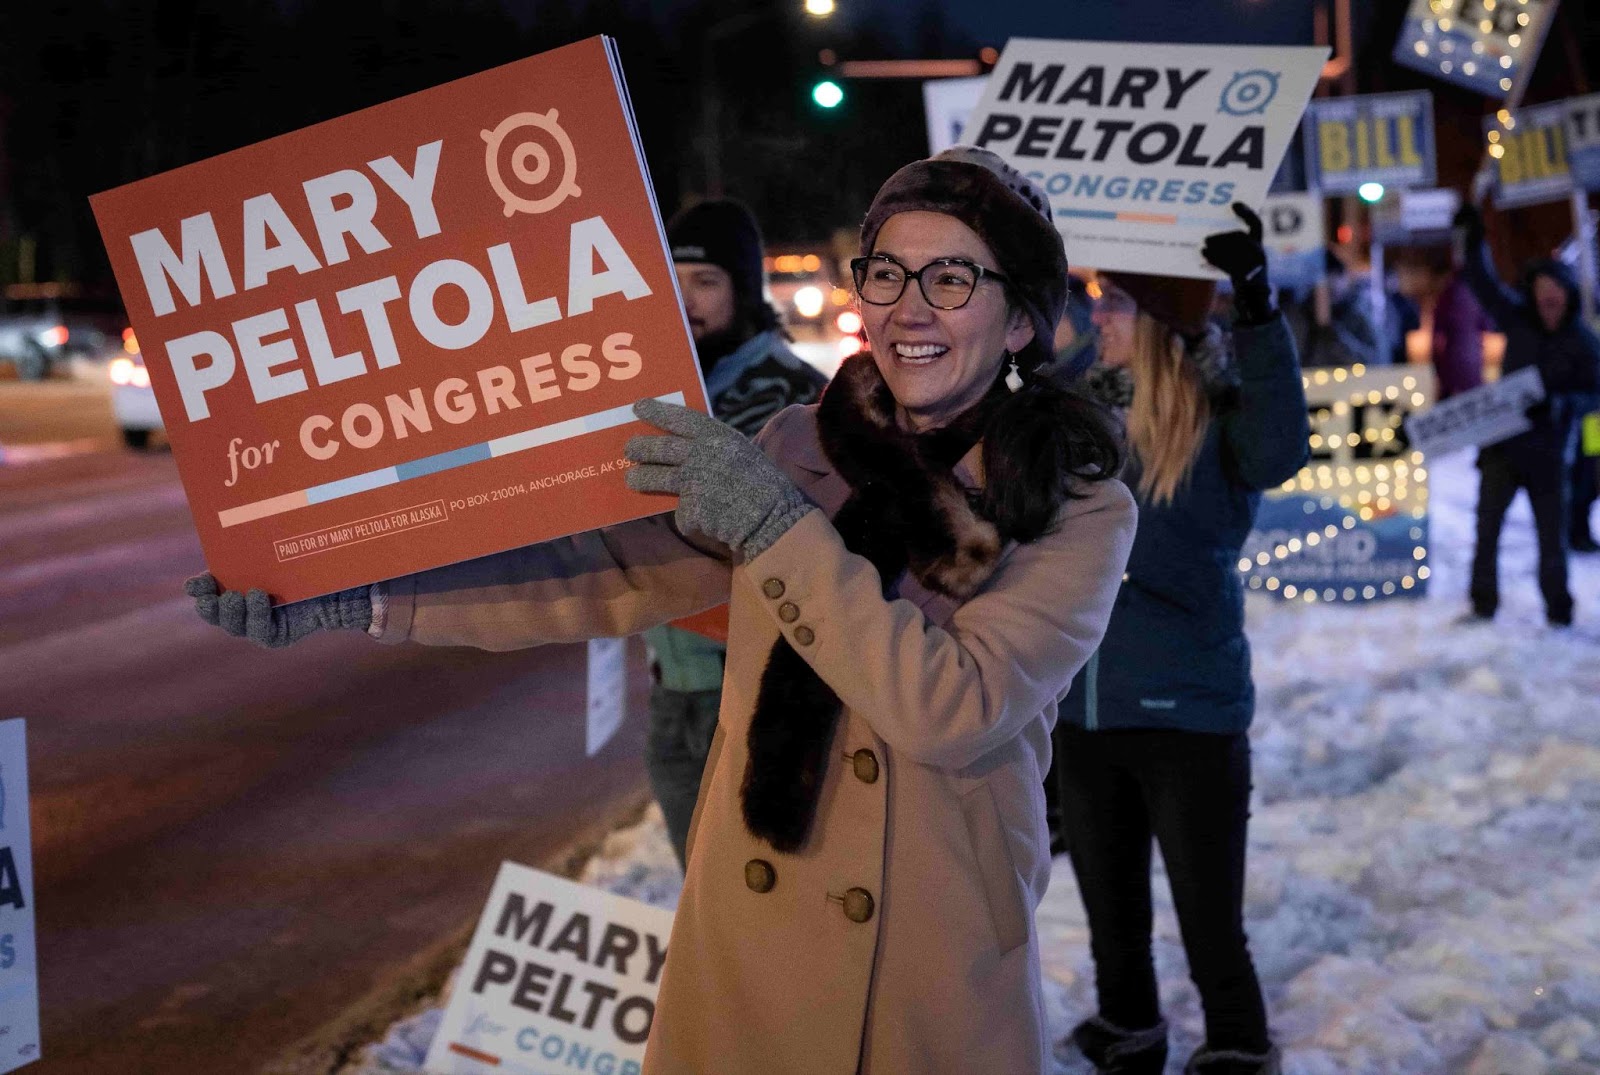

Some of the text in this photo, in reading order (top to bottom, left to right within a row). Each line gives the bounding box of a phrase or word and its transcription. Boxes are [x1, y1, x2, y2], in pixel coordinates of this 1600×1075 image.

[998, 62, 1210, 110] MARY
[974, 113, 1265, 170] PELTOLA
[1319, 117, 1422, 173] BILL
[129, 139, 443, 317] MARY
[165, 215, 653, 422] PELTOLA
[224, 332, 643, 487] for CONGRESS
[279, 541, 299, 557] PAID
[299, 537, 317, 552] FOR
[317, 534, 329, 548] BY
[329, 528, 355, 544] MARY
[355, 519, 391, 538] PELTOLA
[391, 513, 409, 529] FOR
[410, 506, 442, 524] ALASKA
[450, 501, 466, 511] PO
[467, 493, 490, 507] BOX
[491, 484, 528, 501] 210014,
[529, 466, 599, 491] ANCHORAGE,
[600, 461, 615, 474] AK
[495, 892, 668, 984] MARY
[471, 949, 656, 1044] PELTO
